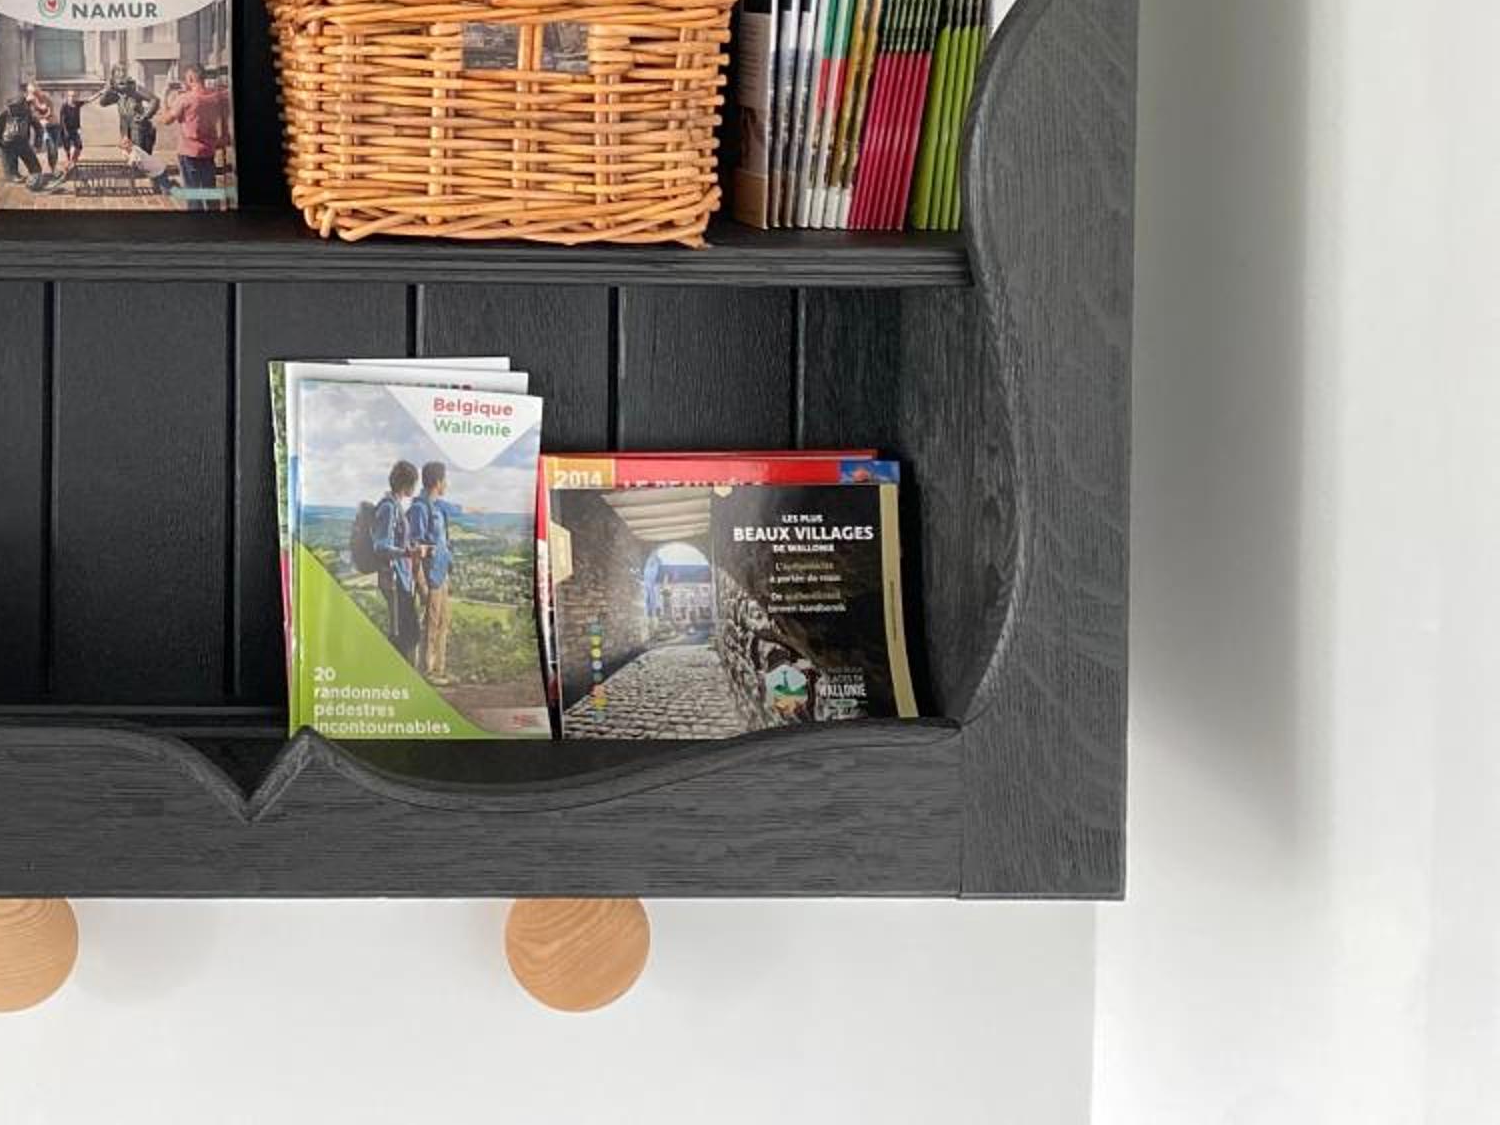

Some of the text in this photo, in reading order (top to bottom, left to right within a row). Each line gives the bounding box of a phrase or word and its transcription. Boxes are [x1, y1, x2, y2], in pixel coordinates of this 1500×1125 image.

[71, 2, 159, 19] NAMUR
[433, 397, 514, 418] Belgique
[434, 418, 512, 437] Wallonie
[553, 469, 603, 488] 2014
[733, 525, 875, 542] BEAUX VILLAGES
[313, 666, 337, 682] 20
[313, 683, 411, 700] randonnées
